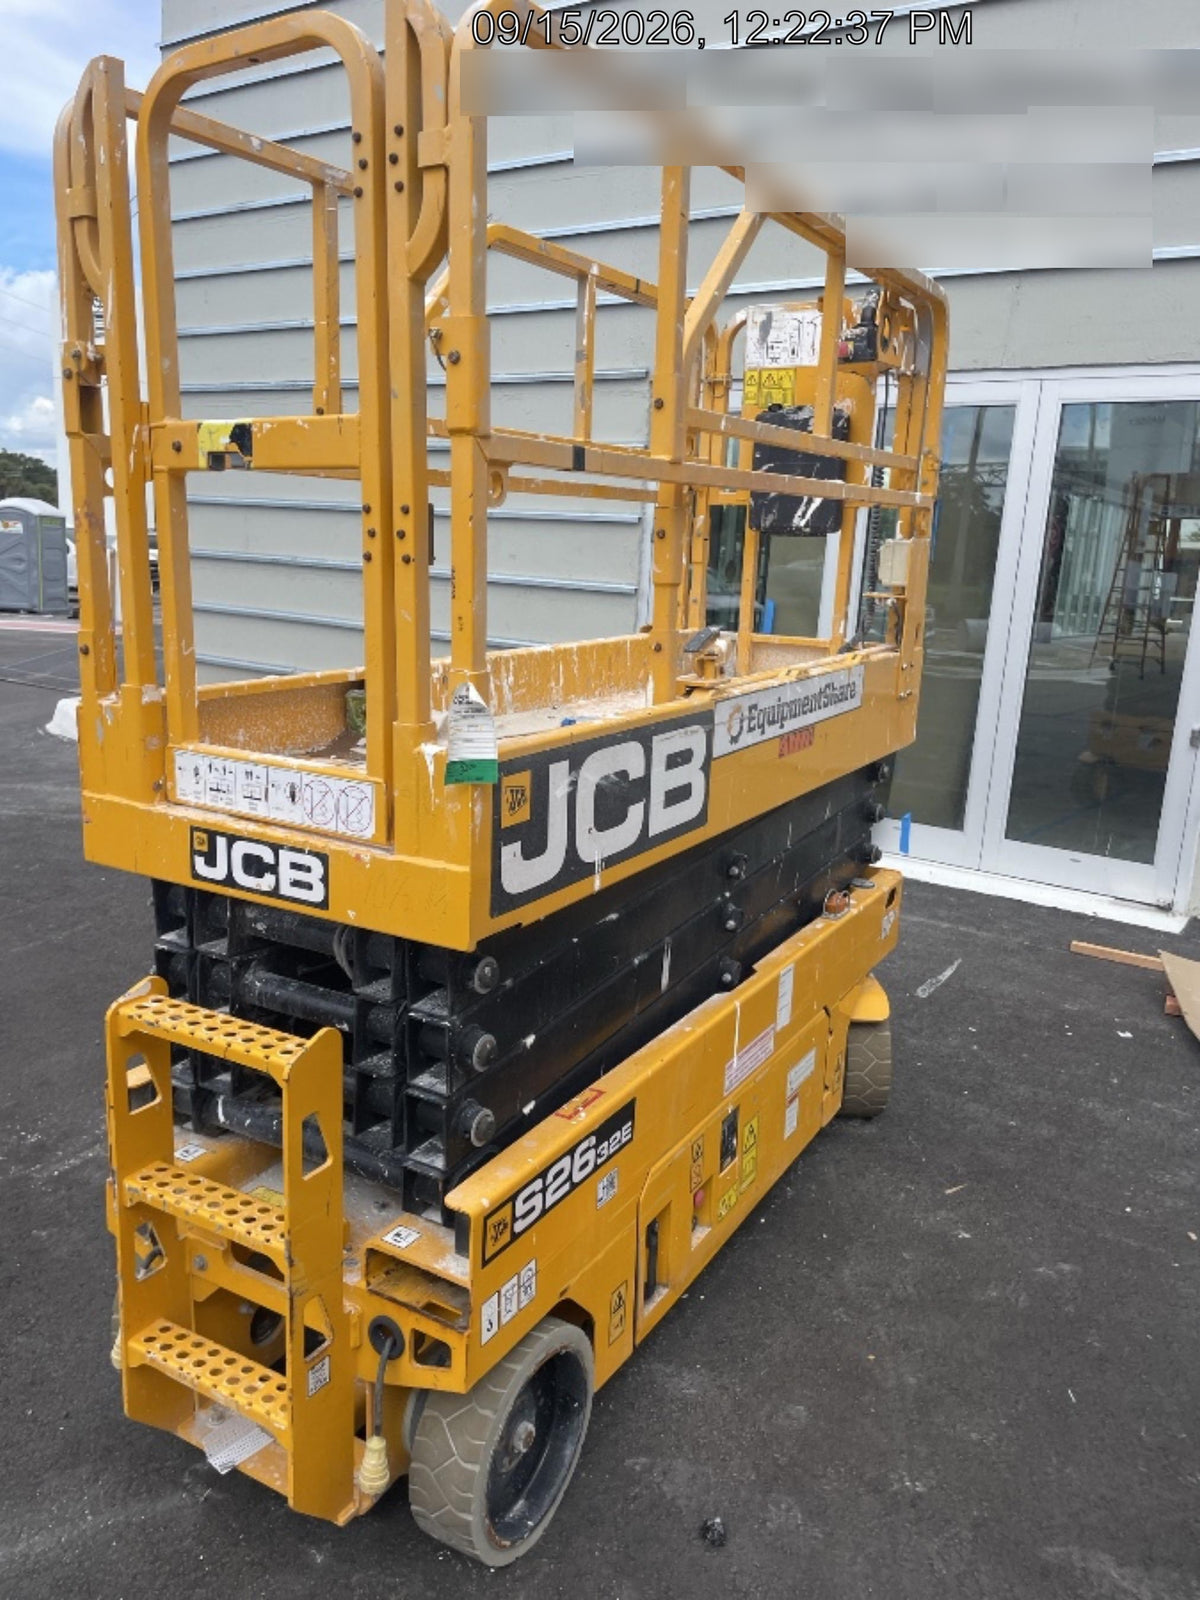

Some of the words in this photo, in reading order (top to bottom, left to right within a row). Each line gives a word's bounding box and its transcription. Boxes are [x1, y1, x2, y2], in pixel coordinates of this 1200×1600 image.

[747, 681, 856, 736] EquipmentShare
[501, 723, 706, 895] JCB
[194, 835, 325, 903] JCB
